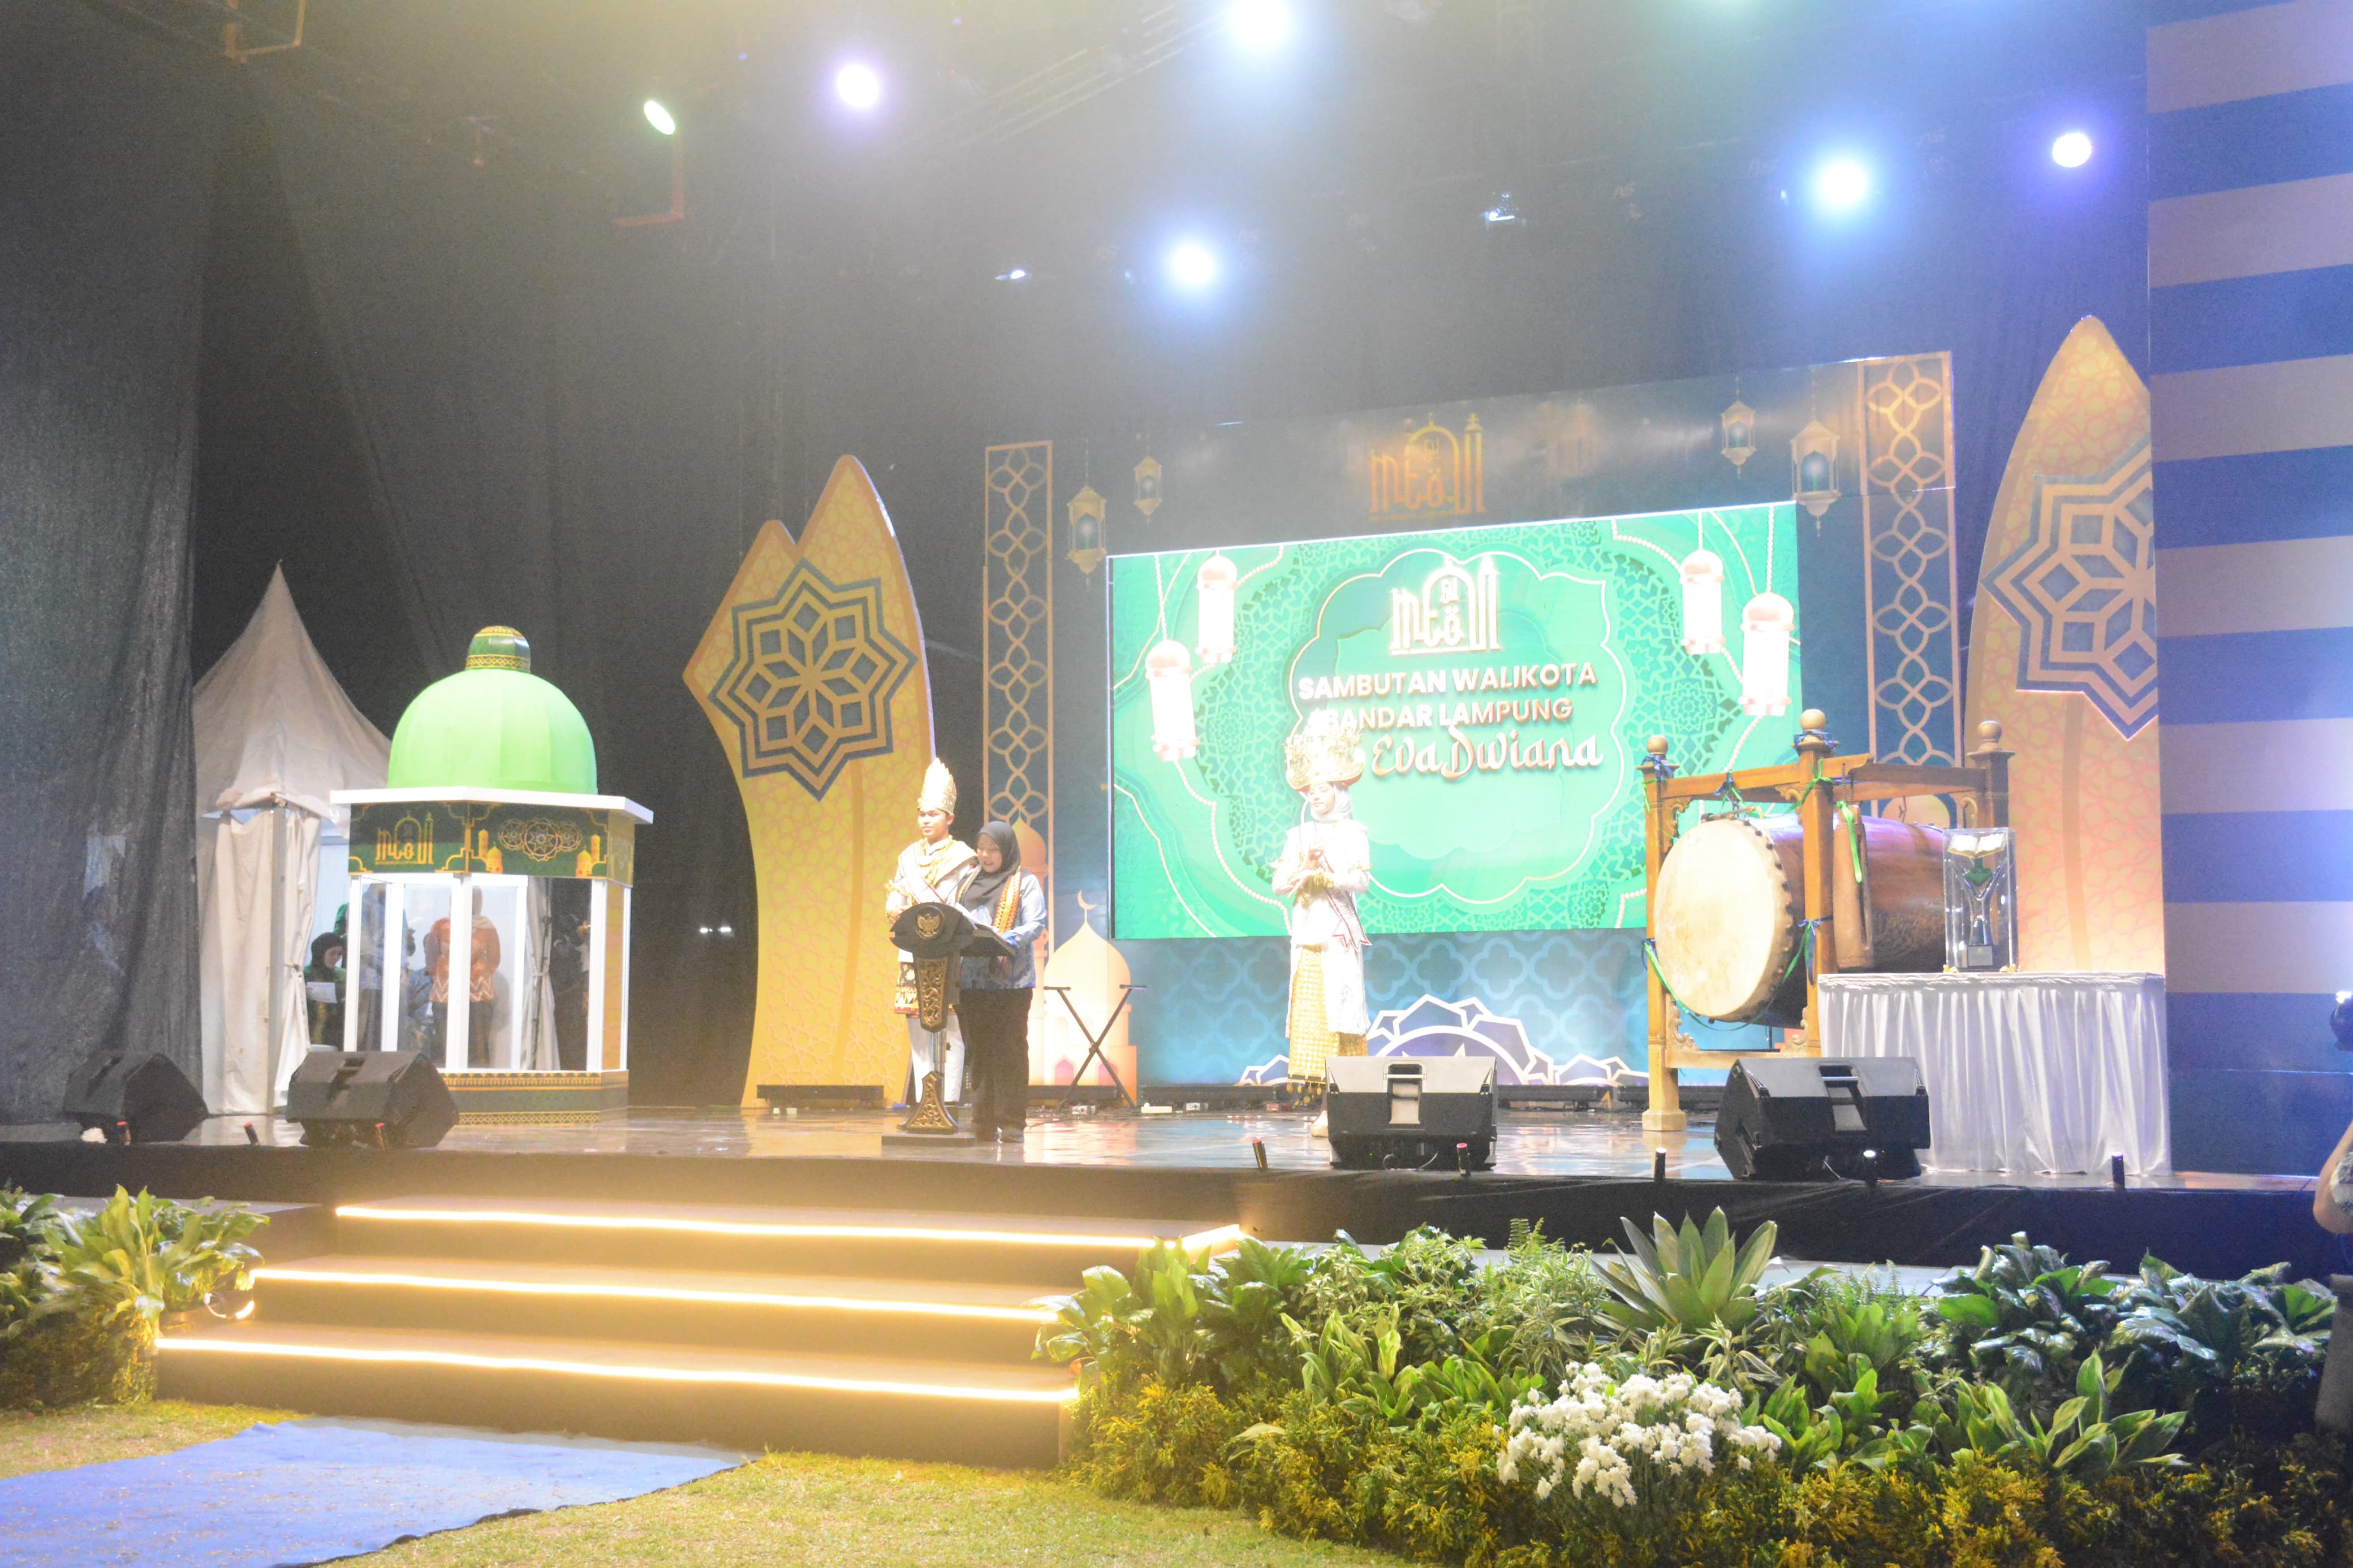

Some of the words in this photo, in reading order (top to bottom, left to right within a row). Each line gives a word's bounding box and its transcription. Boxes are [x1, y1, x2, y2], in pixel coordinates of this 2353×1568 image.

[1298, 671, 1447, 701] SAMBUTAN
[1451, 662, 1598, 693] WALIKOTA
[1322, 705, 1433, 731] BANDAR
[1439, 698, 1574, 728] LAMPUNG
[1371, 735, 1443, 776] Eva
[1440, 724, 1605, 780] Dwiana
